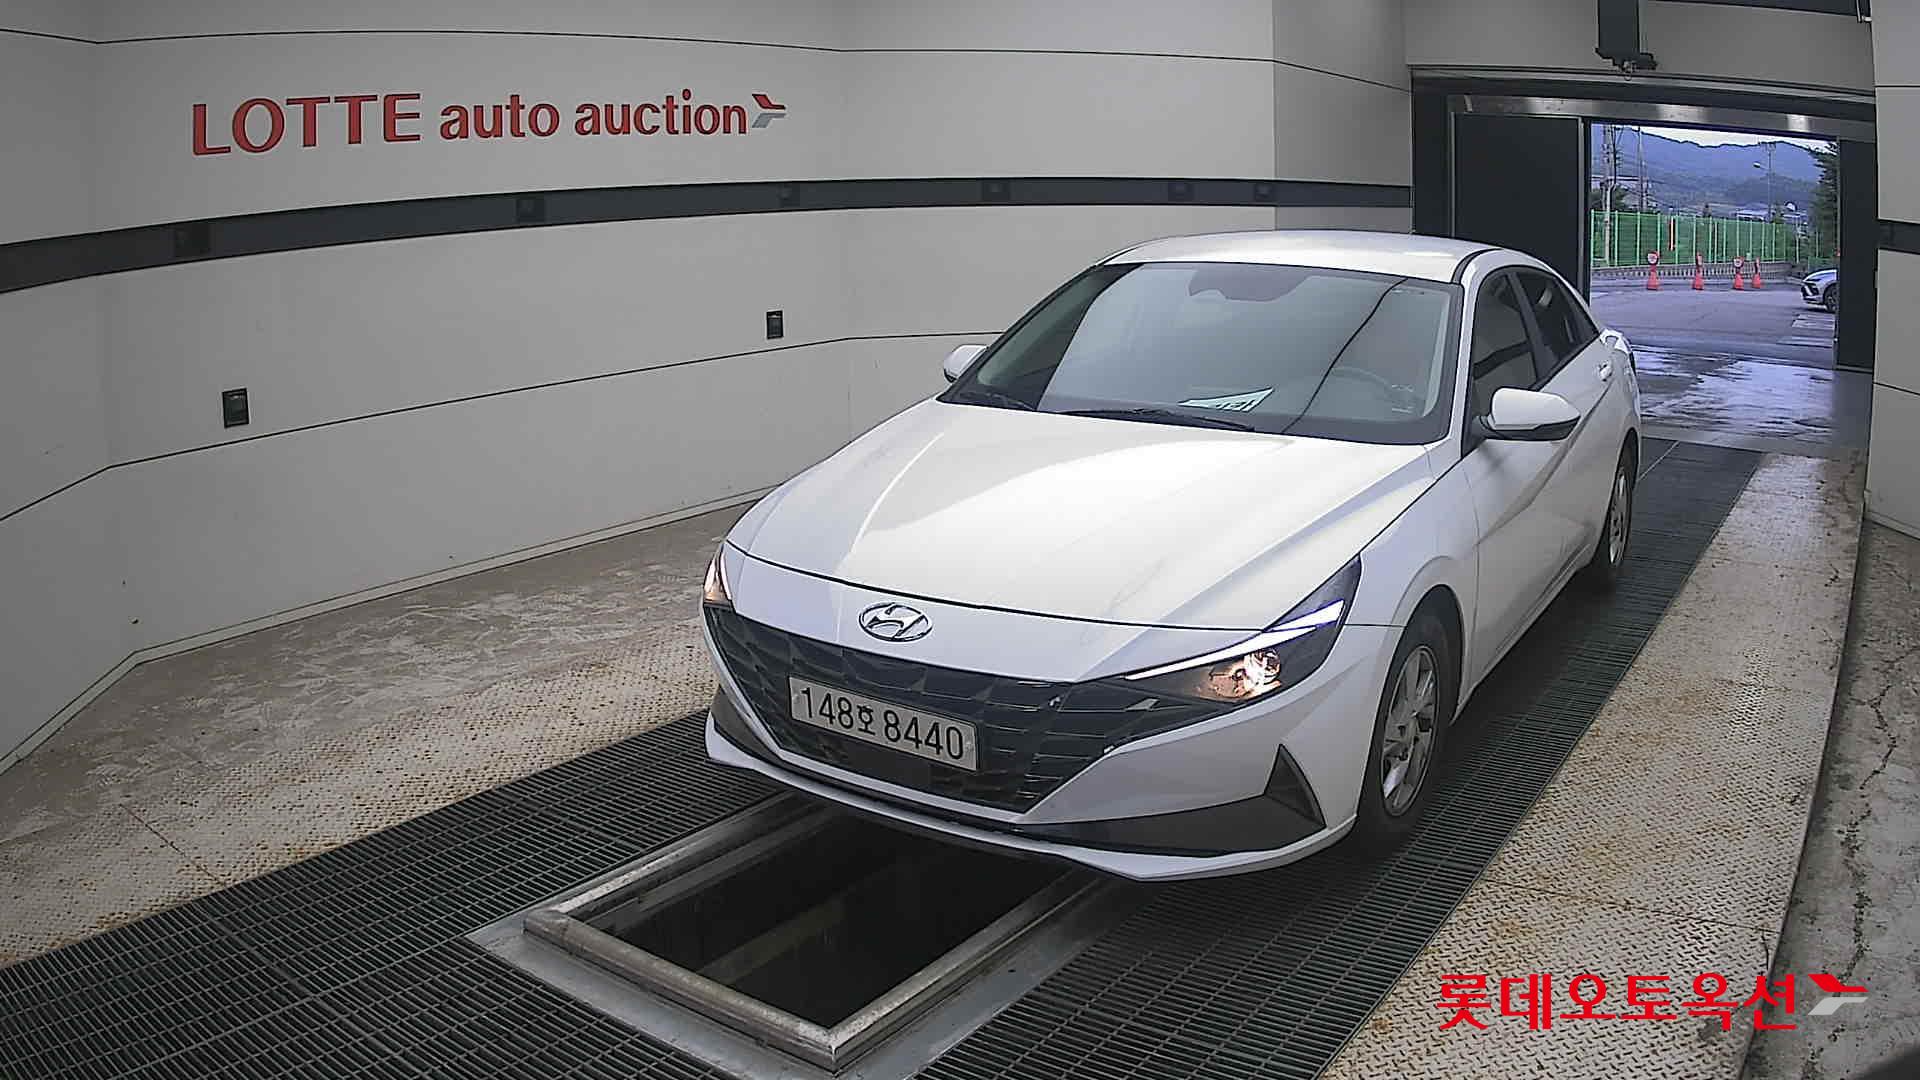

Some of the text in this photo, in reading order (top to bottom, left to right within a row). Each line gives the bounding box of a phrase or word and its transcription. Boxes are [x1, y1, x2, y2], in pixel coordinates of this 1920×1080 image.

[192, 89, 748, 156] LOTTE auto auction
